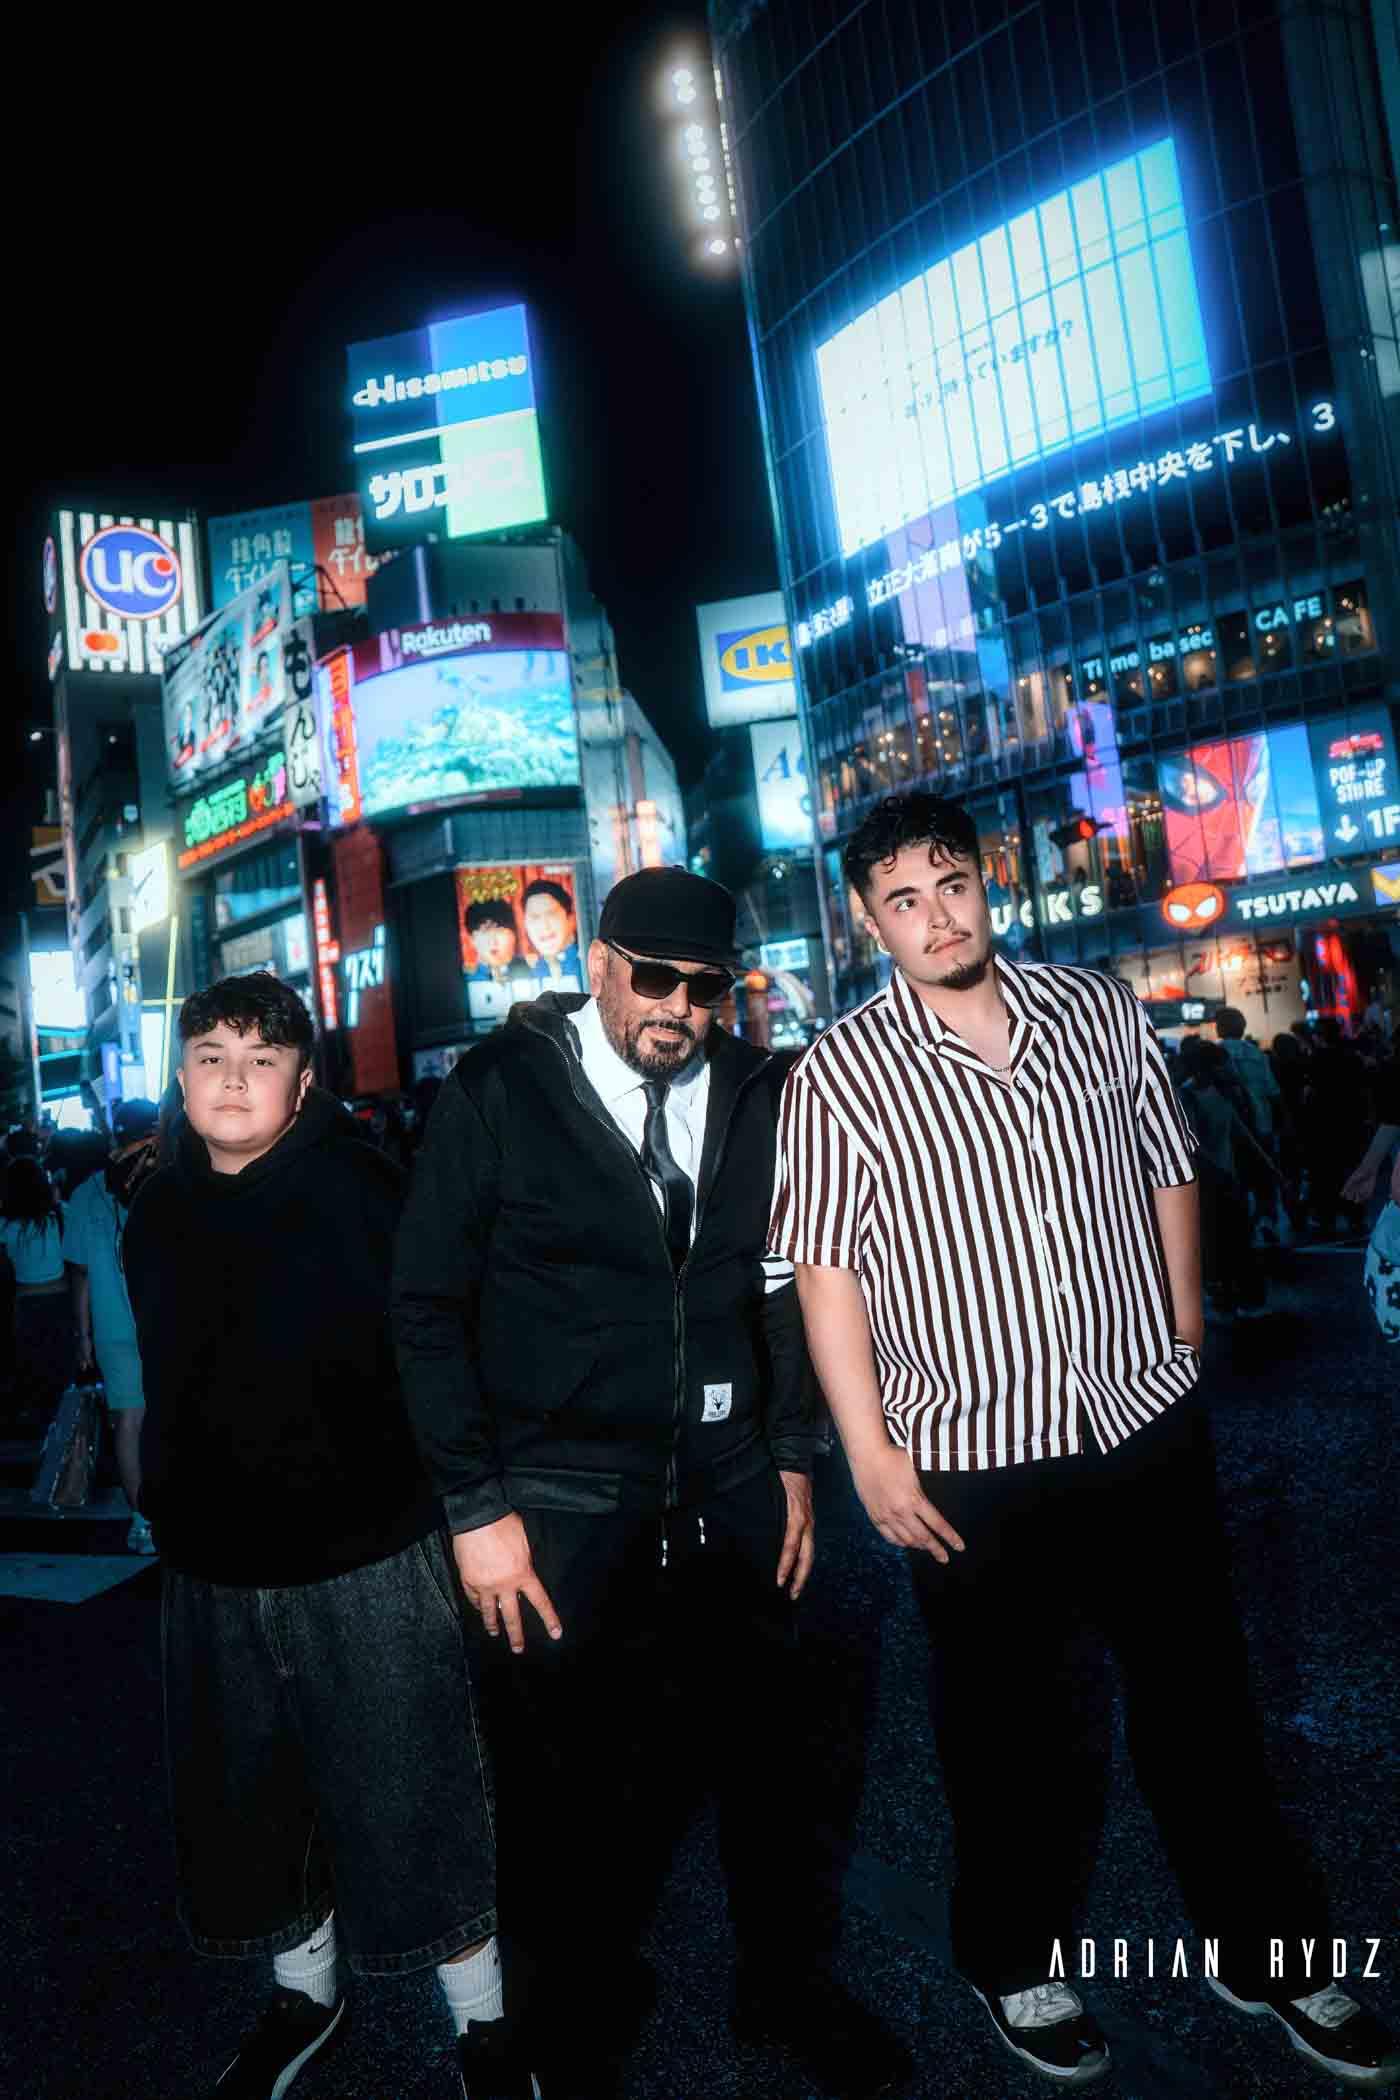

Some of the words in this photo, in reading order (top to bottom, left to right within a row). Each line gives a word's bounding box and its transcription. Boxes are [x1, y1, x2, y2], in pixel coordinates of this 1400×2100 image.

[92, 548, 175, 598] UC
[400, 622, 491, 656] Rakuten
[734, 641, 789, 670] IK
[1329, 758, 1386, 788] POP-UP
[1366, 804, 1400, 838] 1F
[1236, 881, 1358, 920] TSUTAYA
